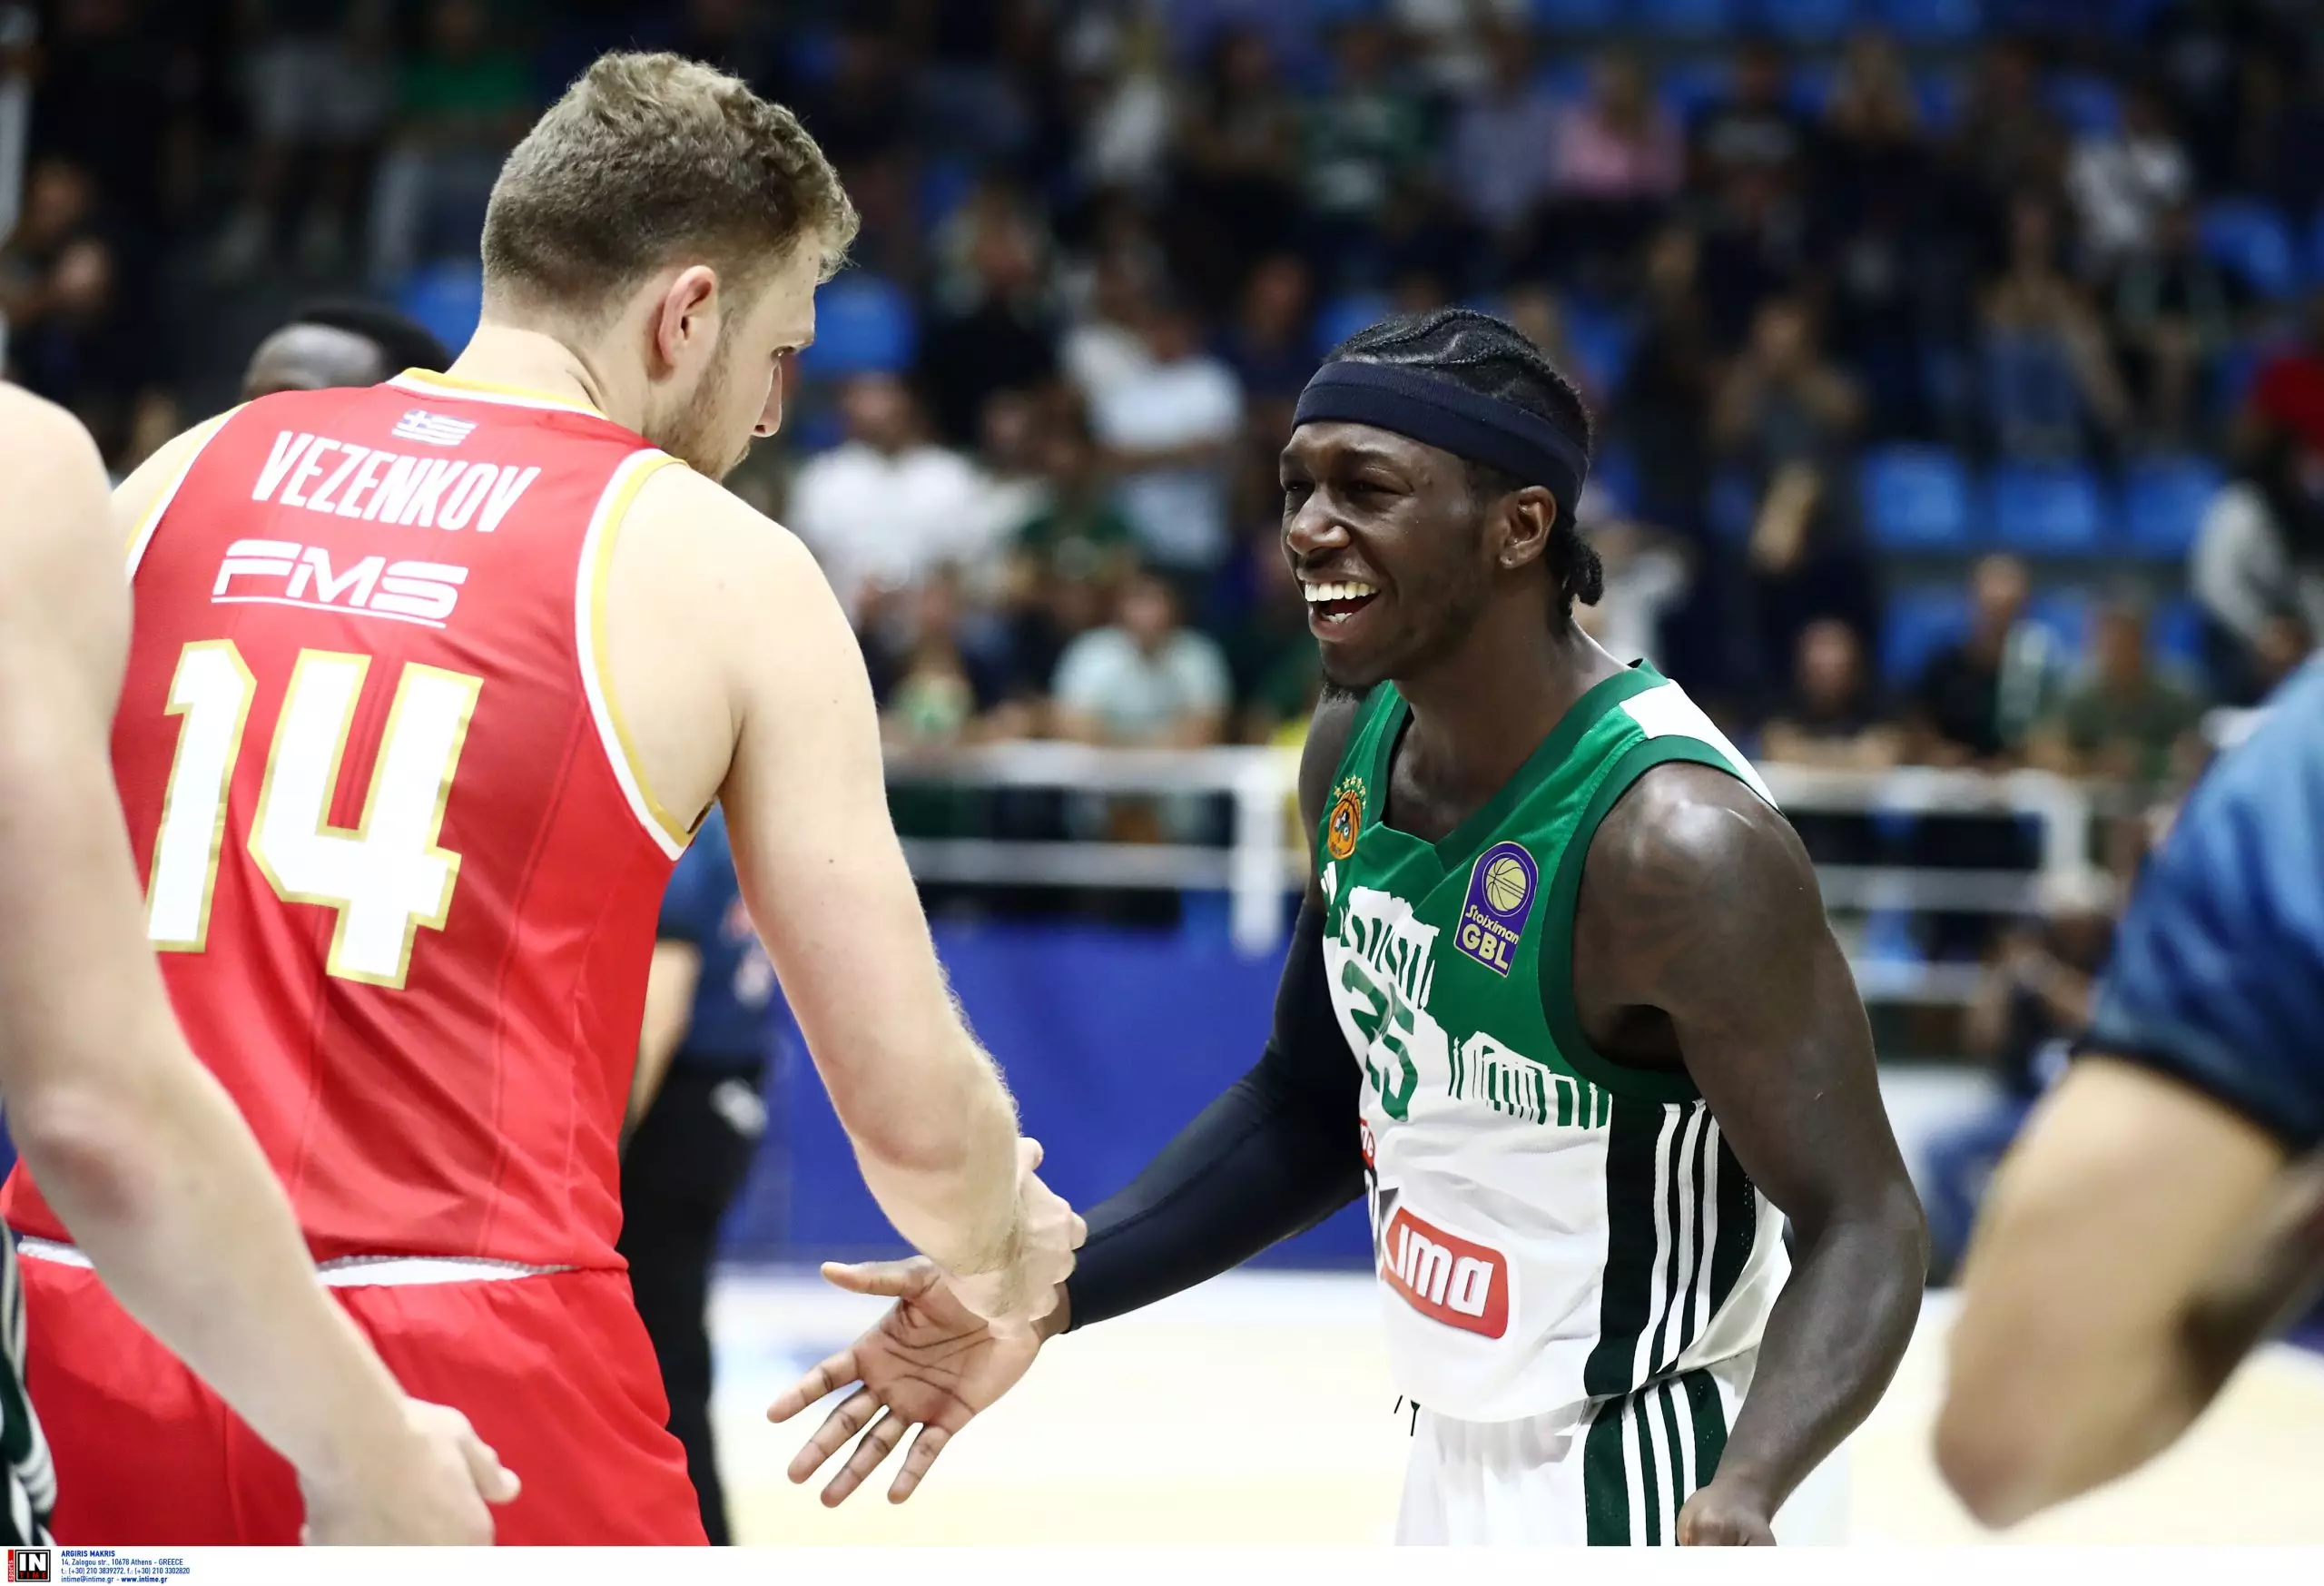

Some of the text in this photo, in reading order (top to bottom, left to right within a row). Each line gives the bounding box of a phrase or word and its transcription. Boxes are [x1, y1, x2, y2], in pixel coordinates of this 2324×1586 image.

[251, 430, 542, 533] VEZENKOV
[212, 538, 469, 623] FMS
[147, 637, 485, 990] 14
[1462, 923, 1509, 970] GBL
[1465, 904, 1520, 945] Stoiximan
